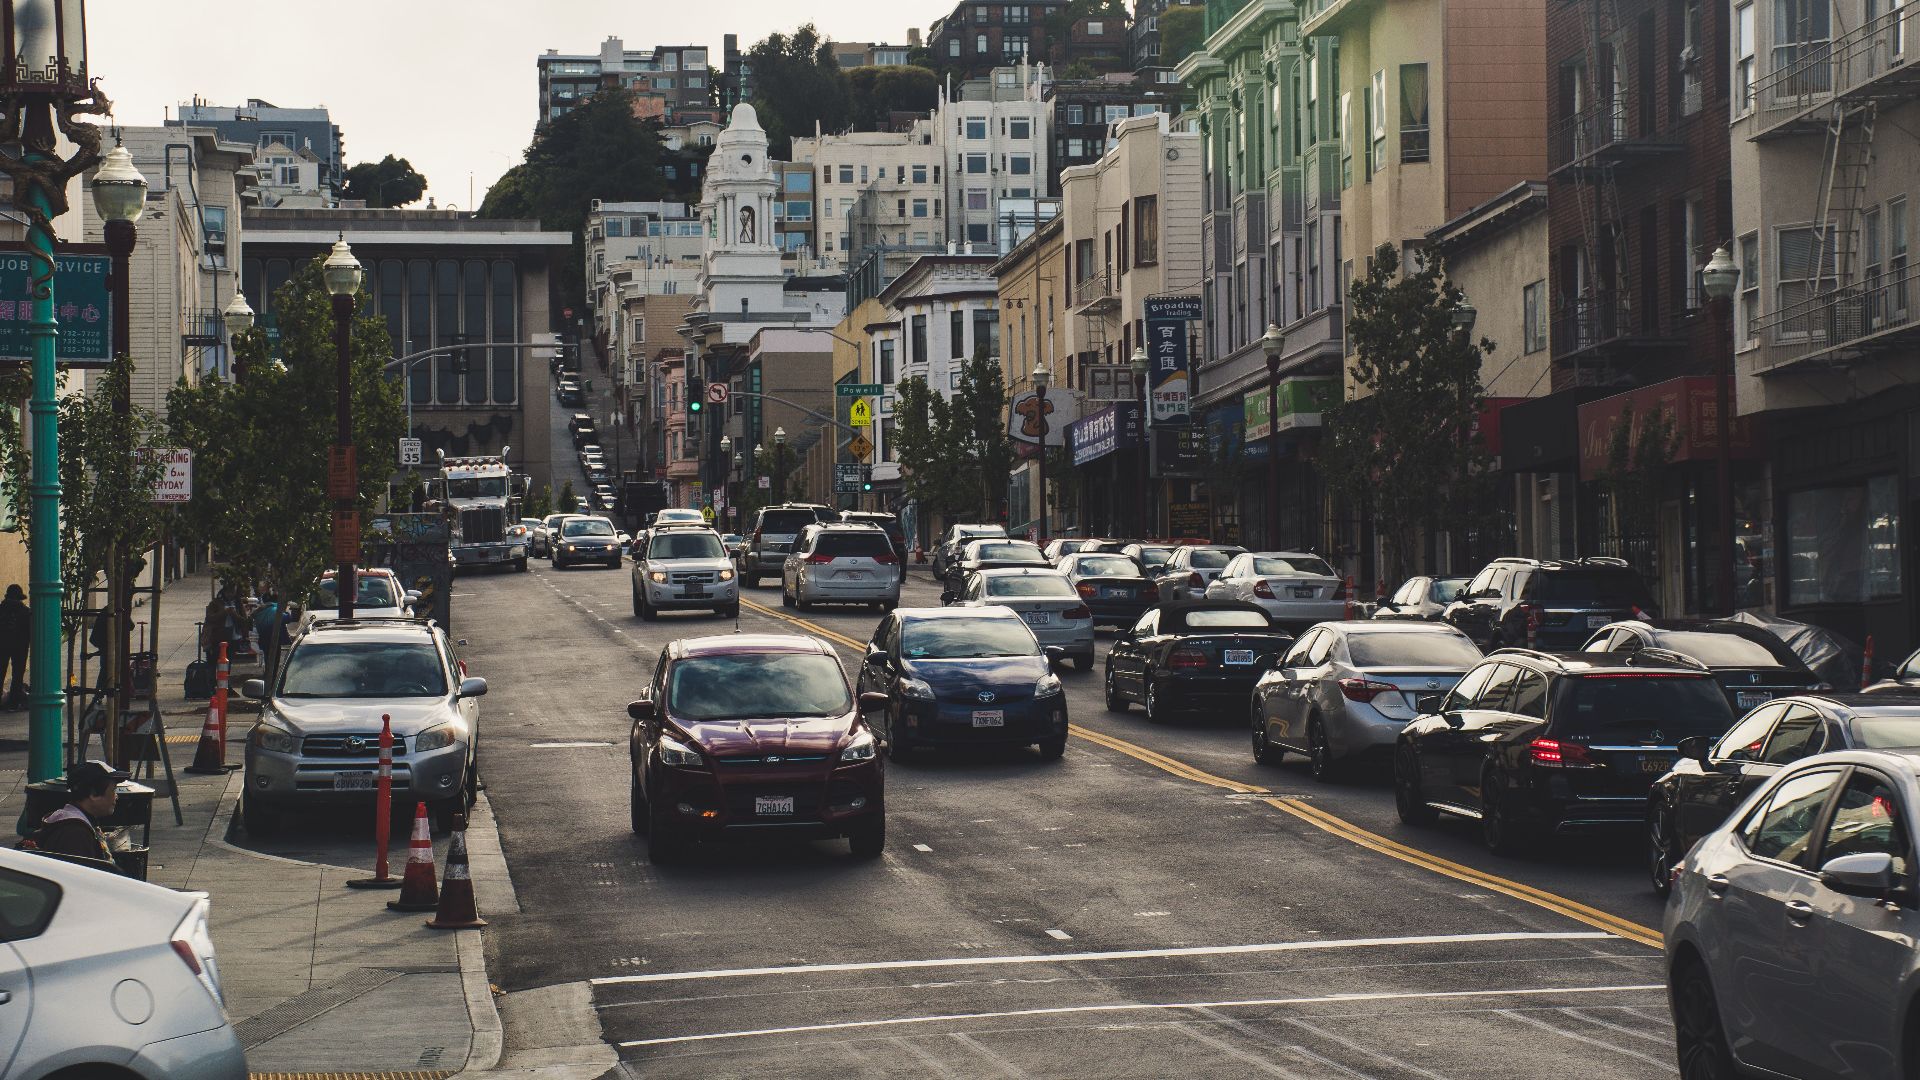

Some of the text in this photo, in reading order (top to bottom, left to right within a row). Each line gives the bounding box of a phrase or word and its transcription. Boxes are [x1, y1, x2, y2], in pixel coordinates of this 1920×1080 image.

[1157, 326, 1179, 371] 百老匯
[843, 387, 879, 395] Powell
[404, 453, 419, 462] 35
[756, 802, 793, 813] 7GHA161
